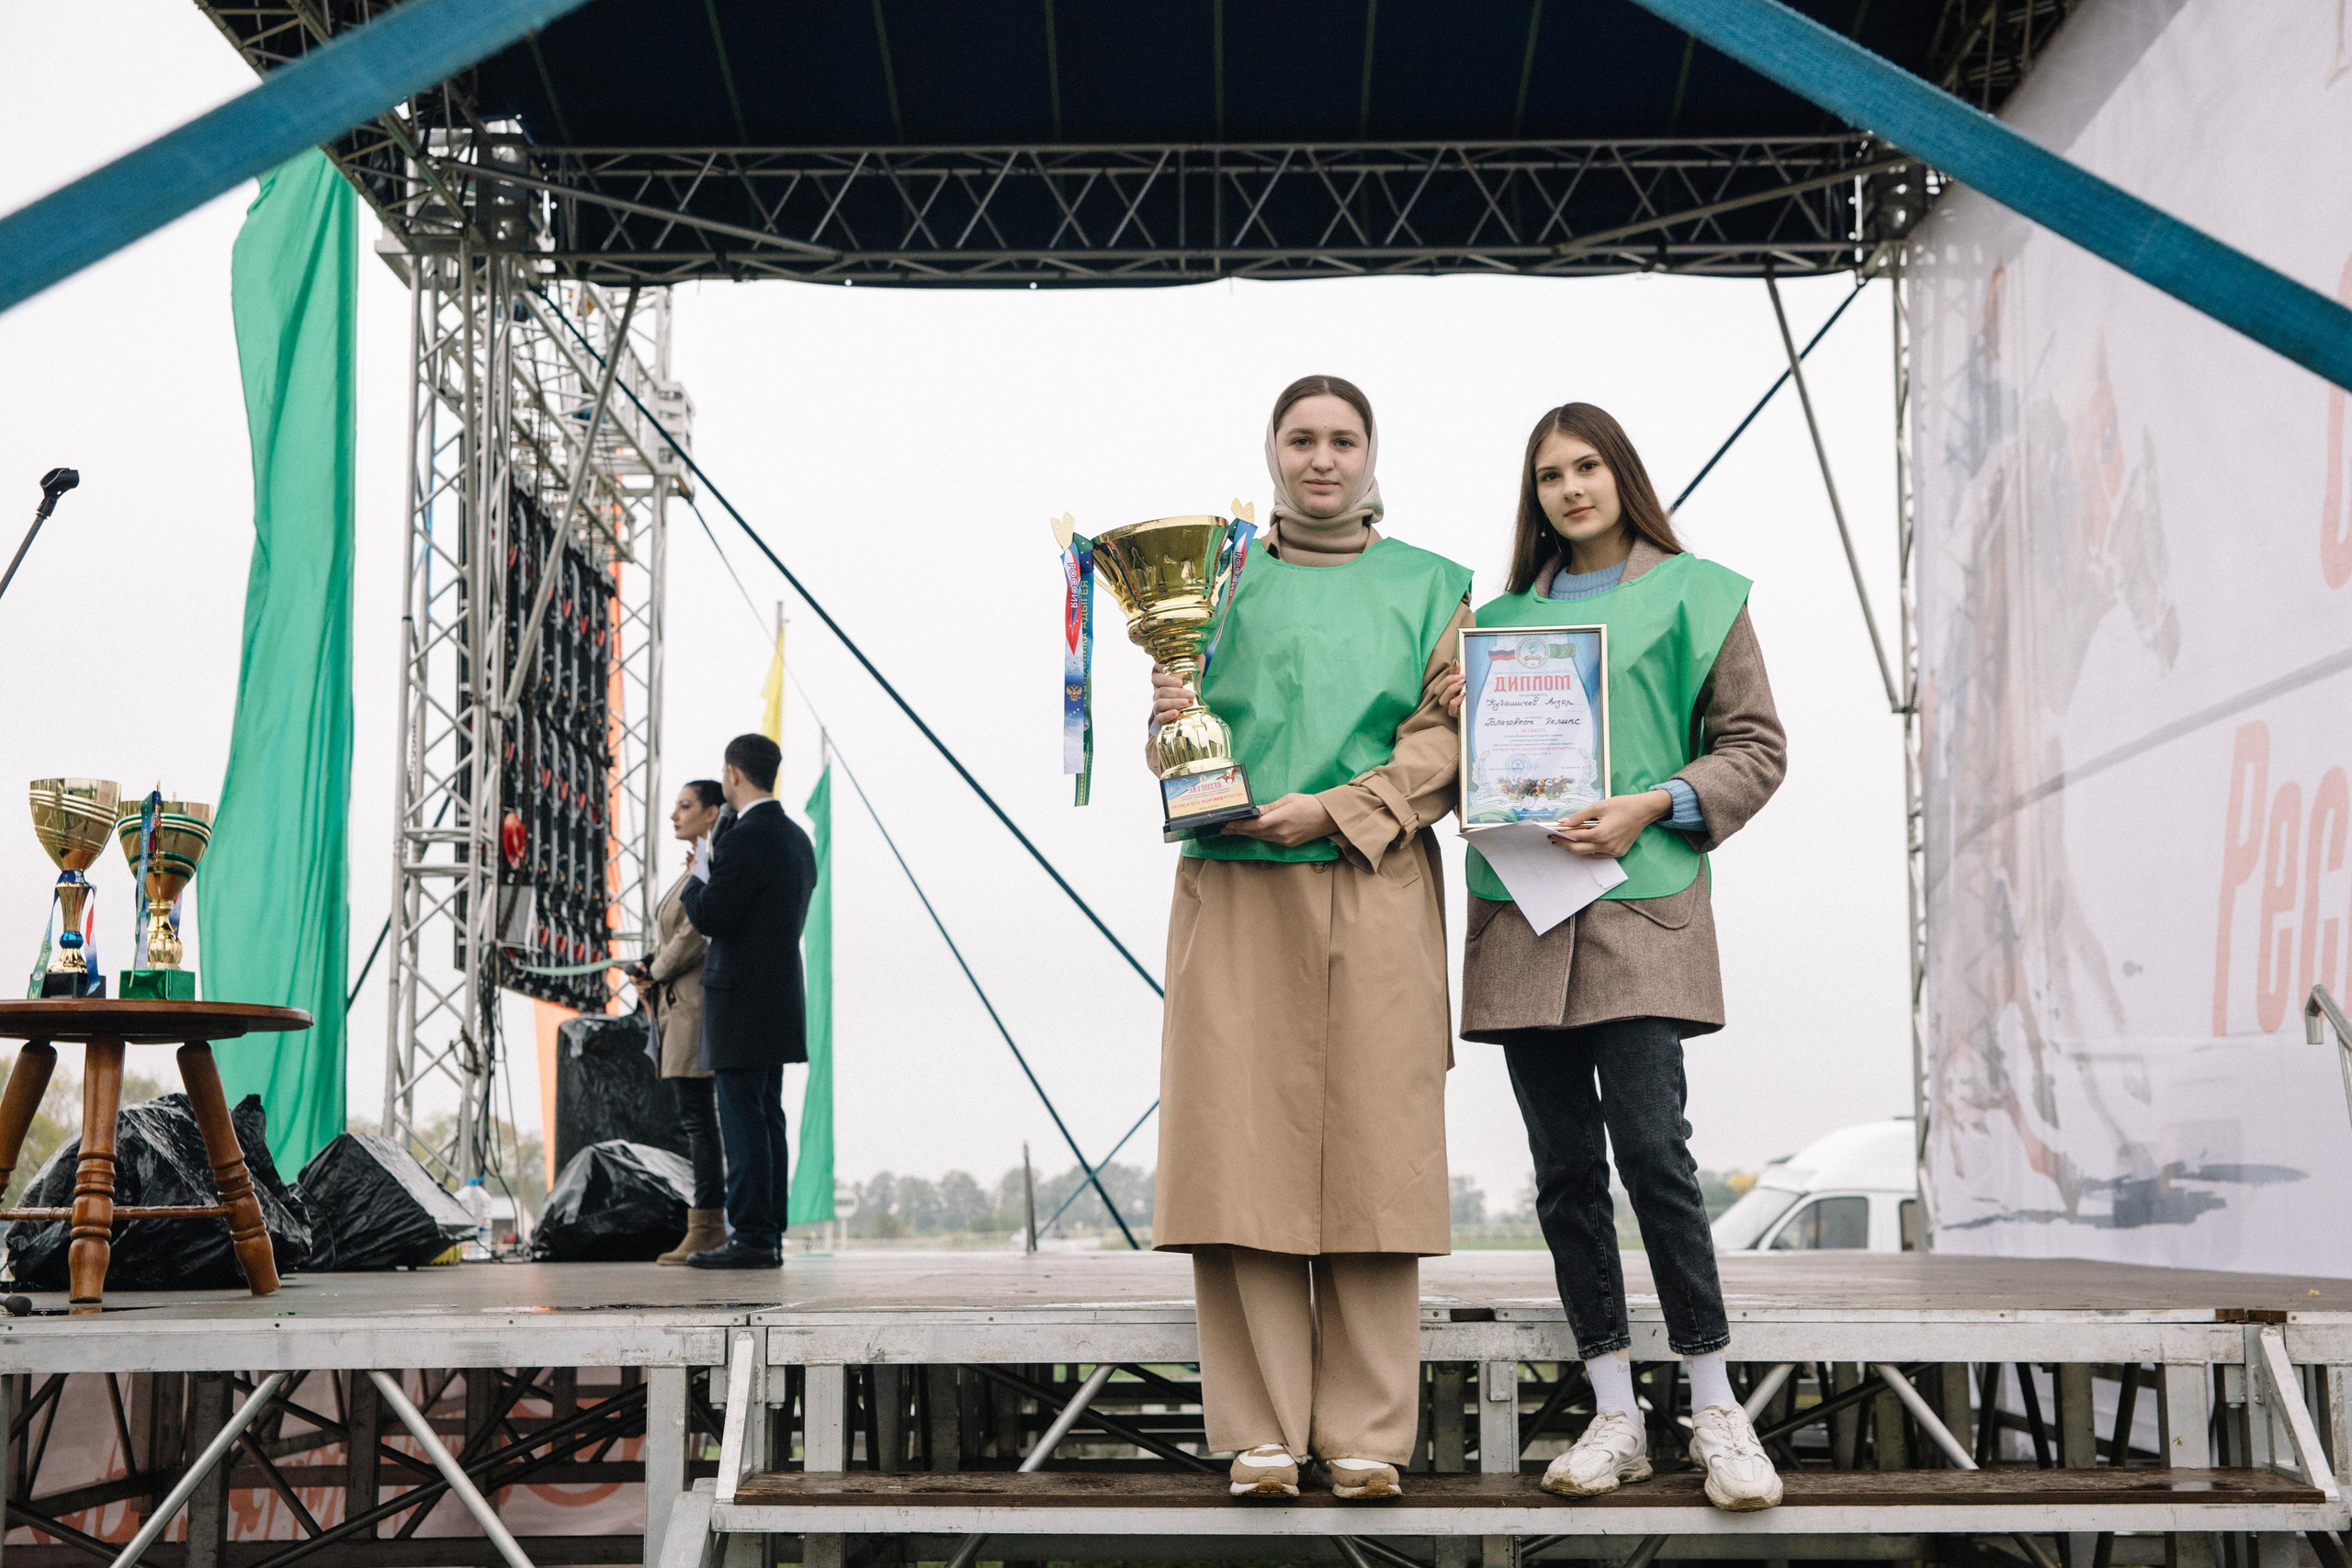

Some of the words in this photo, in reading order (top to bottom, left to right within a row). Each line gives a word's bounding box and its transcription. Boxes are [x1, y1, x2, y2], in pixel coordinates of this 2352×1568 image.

[1068, 562, 1078, 609] РОССИЯ
[1494, 674, 1571, 693] ДИПЛОМ
[2212, 719, 2352, 1038] Рес
